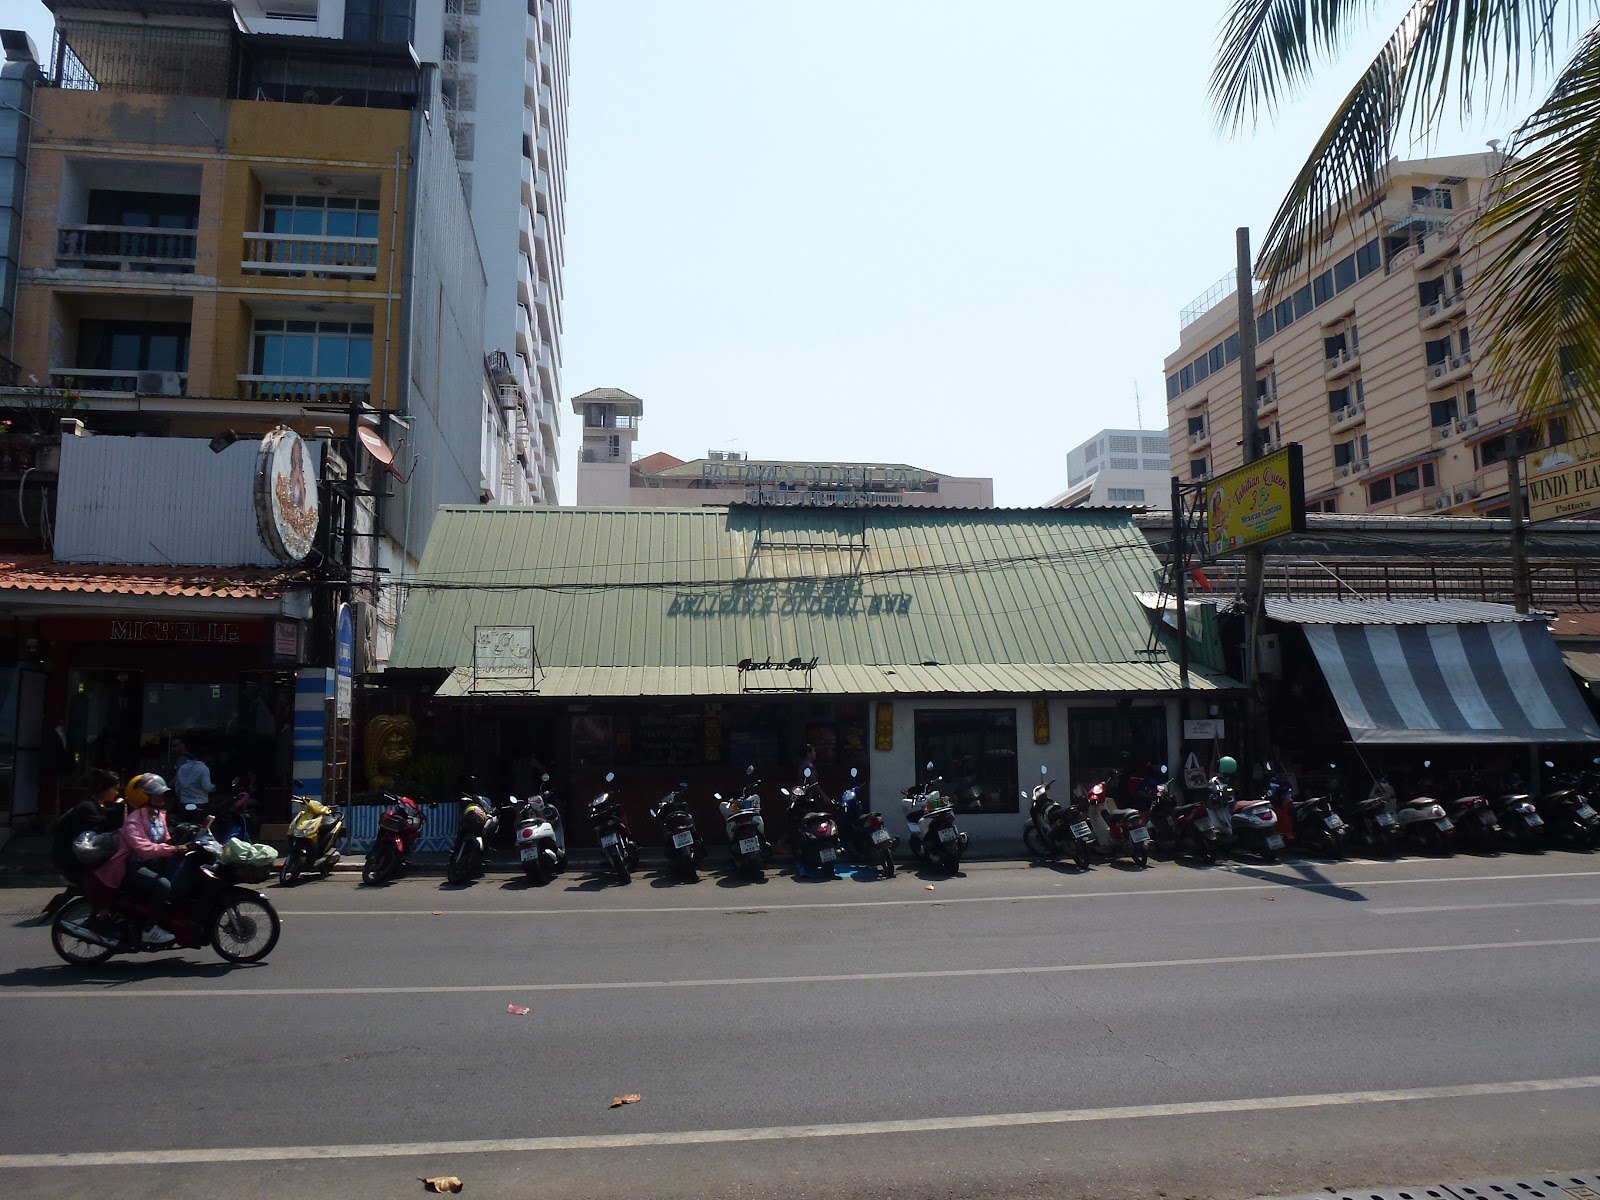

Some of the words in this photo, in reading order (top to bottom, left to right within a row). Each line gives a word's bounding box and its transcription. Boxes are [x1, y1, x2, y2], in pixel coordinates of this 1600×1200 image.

[702, 463, 796, 487] PATTAYA'S
[803, 464, 877, 488] OLDEST
[885, 467, 923, 491] BAR
[1263, 466, 1288, 490] Queen
[1529, 472, 1570, 503] WINDY
[1574, 465, 1600, 492] PLA
[1555, 500, 1591, 514] Pattaya
[110, 620, 240, 642] MICHELLE
